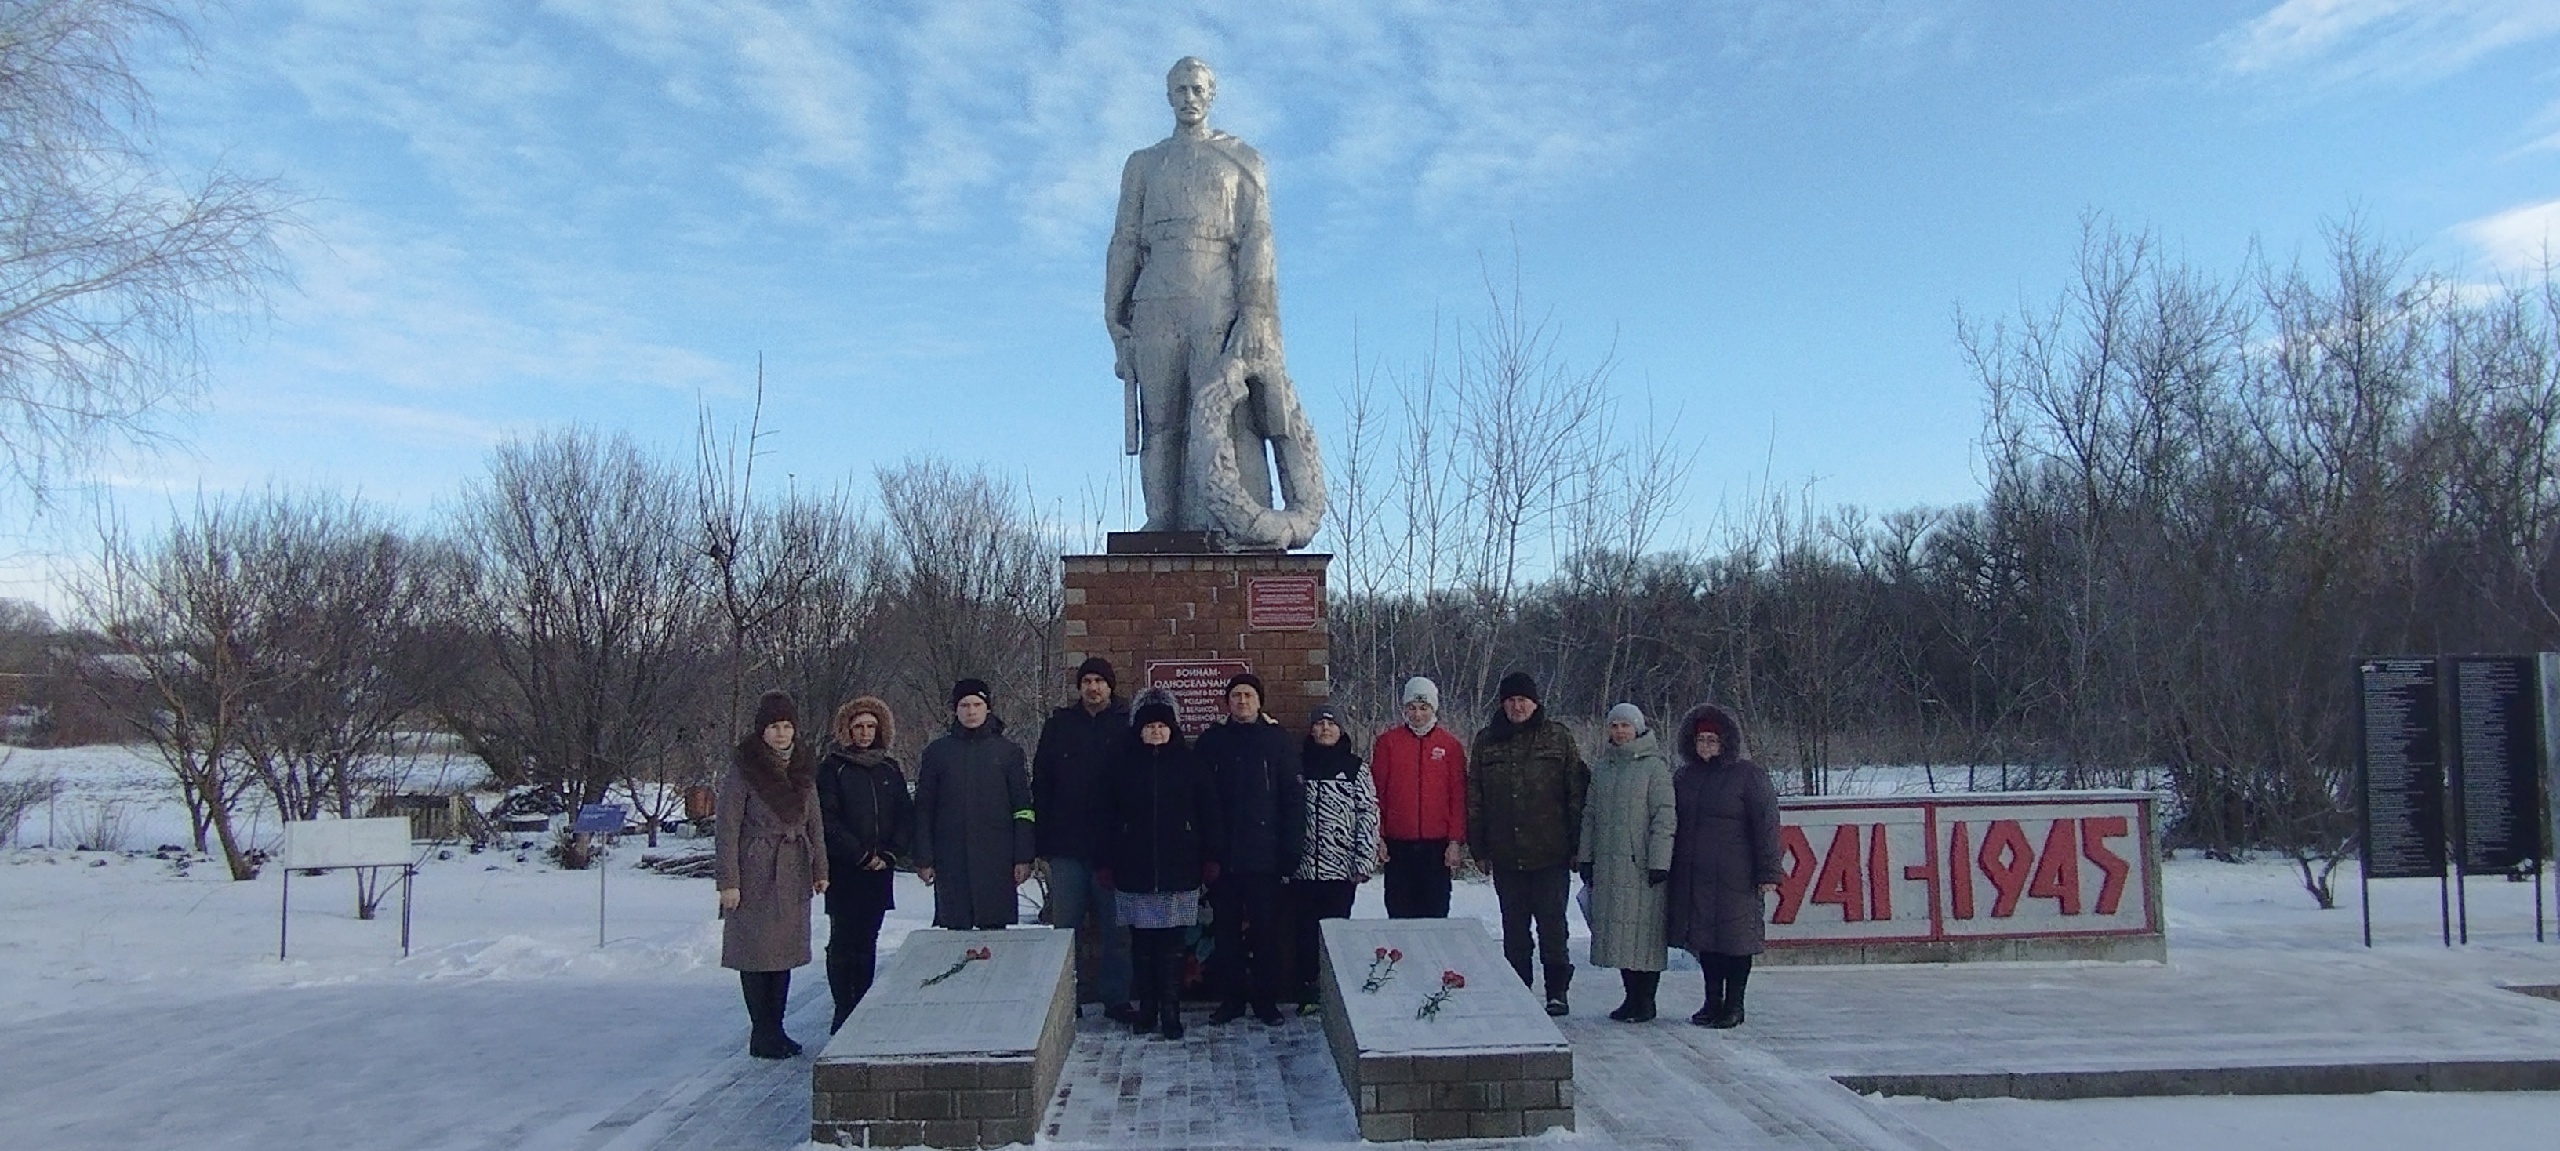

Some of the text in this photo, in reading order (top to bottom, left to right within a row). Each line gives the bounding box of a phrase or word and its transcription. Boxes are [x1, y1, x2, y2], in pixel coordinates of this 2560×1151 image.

[1176, 668, 1221, 677] ВОИНАМ-
[1186, 704, 1219, 713] ВЕЛИКОЙ
[1773, 817, 2129, 924] 941-1945
